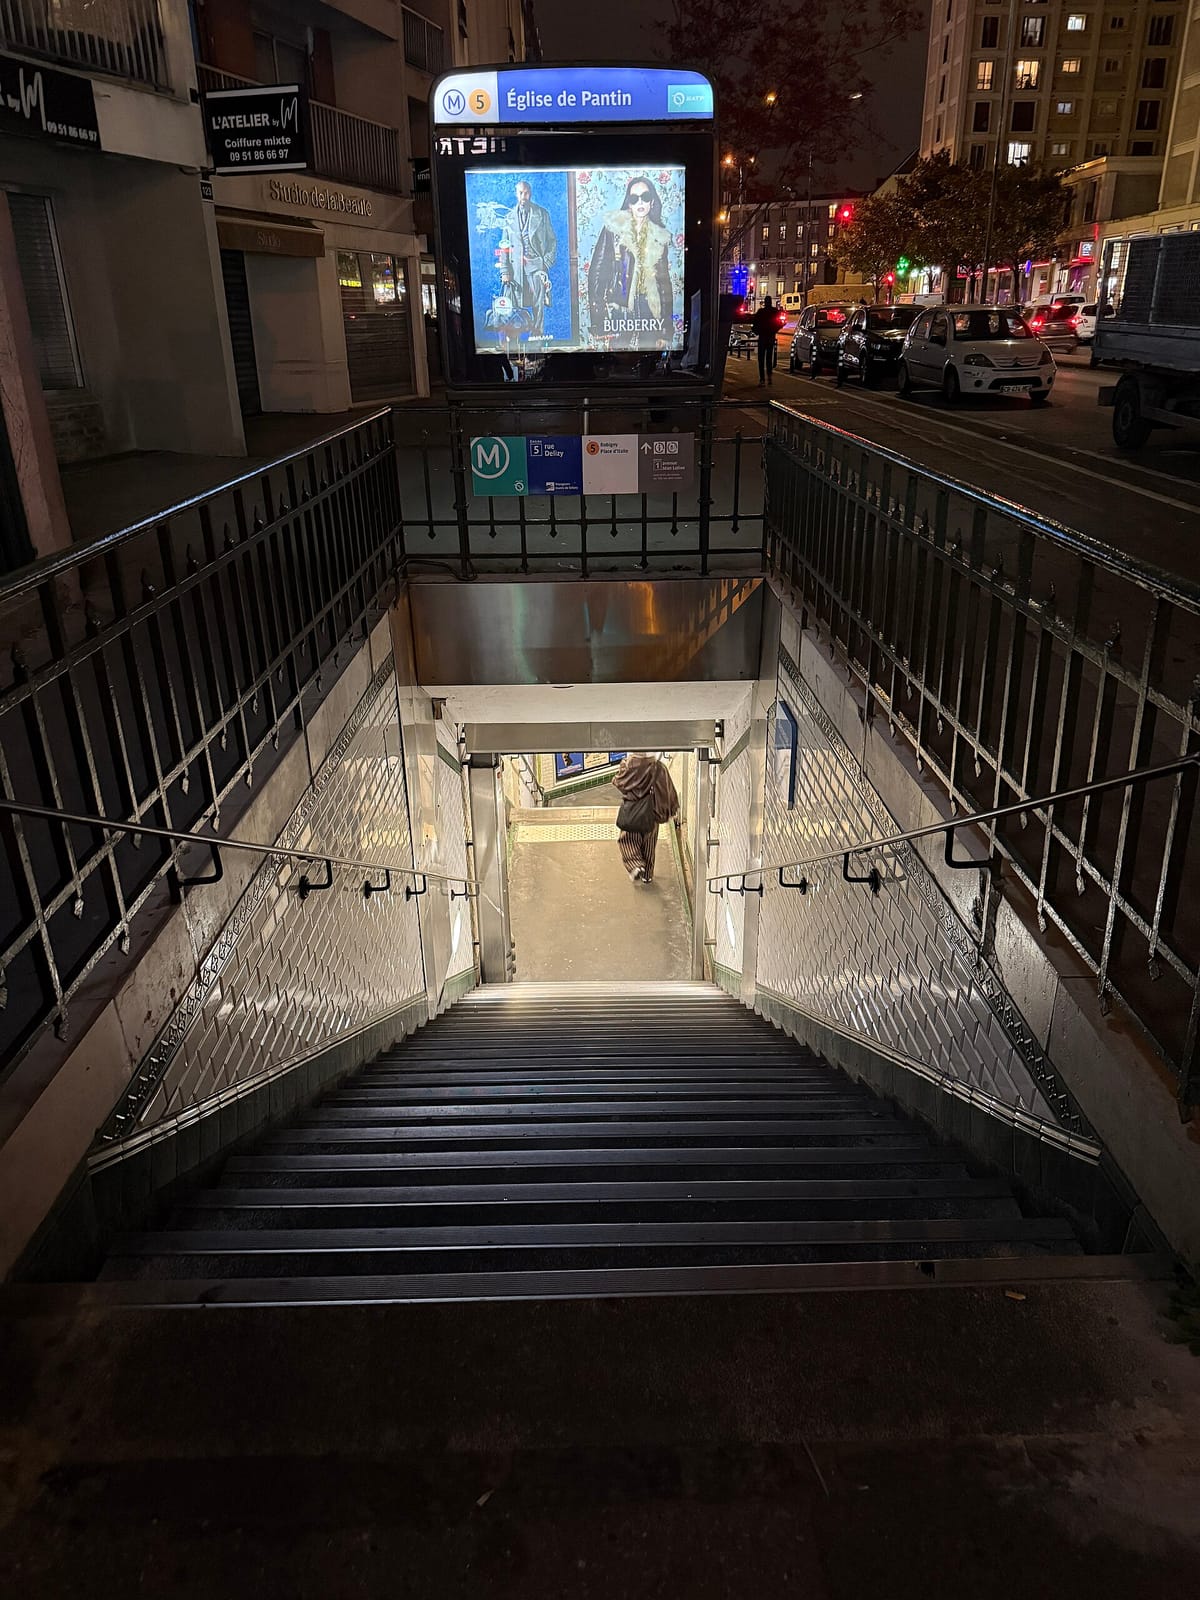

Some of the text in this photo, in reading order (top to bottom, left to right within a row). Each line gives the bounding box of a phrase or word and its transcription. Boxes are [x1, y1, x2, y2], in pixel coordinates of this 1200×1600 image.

[476, 94, 484, 110] 5
[507, 88, 632, 111] Église de Pantin
[47, 121, 57, 134] 09
[58, 123, 67, 136] 51
[212, 113, 270, 130] L'ATELIER
[224, 135, 292, 149] Coiffure mixte
[229, 149, 289, 162] 09 51 86 66 97
[269, 179, 309, 205] Studio
[311, 187, 326, 208] de
[326, 189, 336, 210] la
[603, 318, 665, 332] BURBERRY
[534, 445, 540, 454] 5
[590, 444, 596, 453] 5
[477, 444, 500, 469] M
